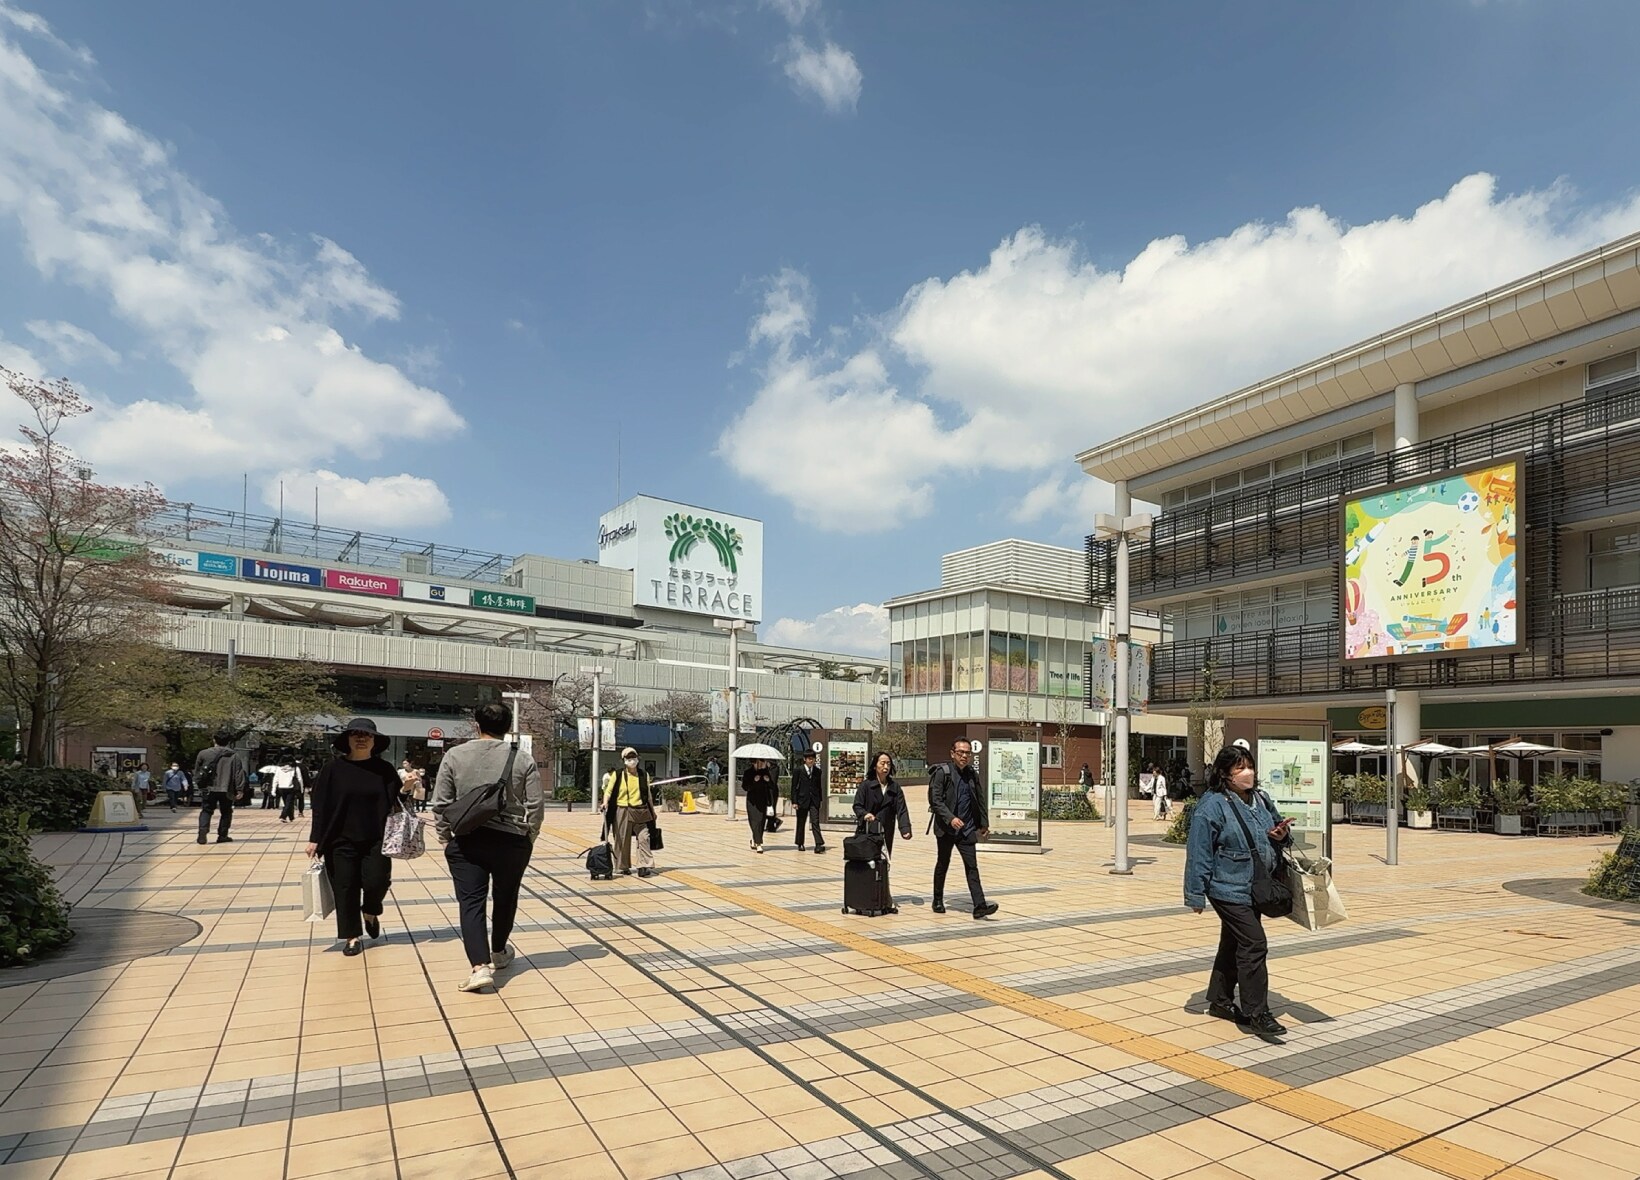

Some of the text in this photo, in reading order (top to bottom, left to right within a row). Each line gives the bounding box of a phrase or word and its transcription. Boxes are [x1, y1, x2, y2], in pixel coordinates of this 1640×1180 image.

[339, 575, 388, 590] Rakuten
[669, 567, 738, 588] たまプラーザ
[430, 588, 445, 598] GU
[651, 579, 752, 613] TERRACE
[1390, 587, 1458, 602] ANNIVERSARY
[1049, 671, 1064, 680] Tree
[1070, 673, 1080, 681] life
[123, 758, 140, 768] GU
